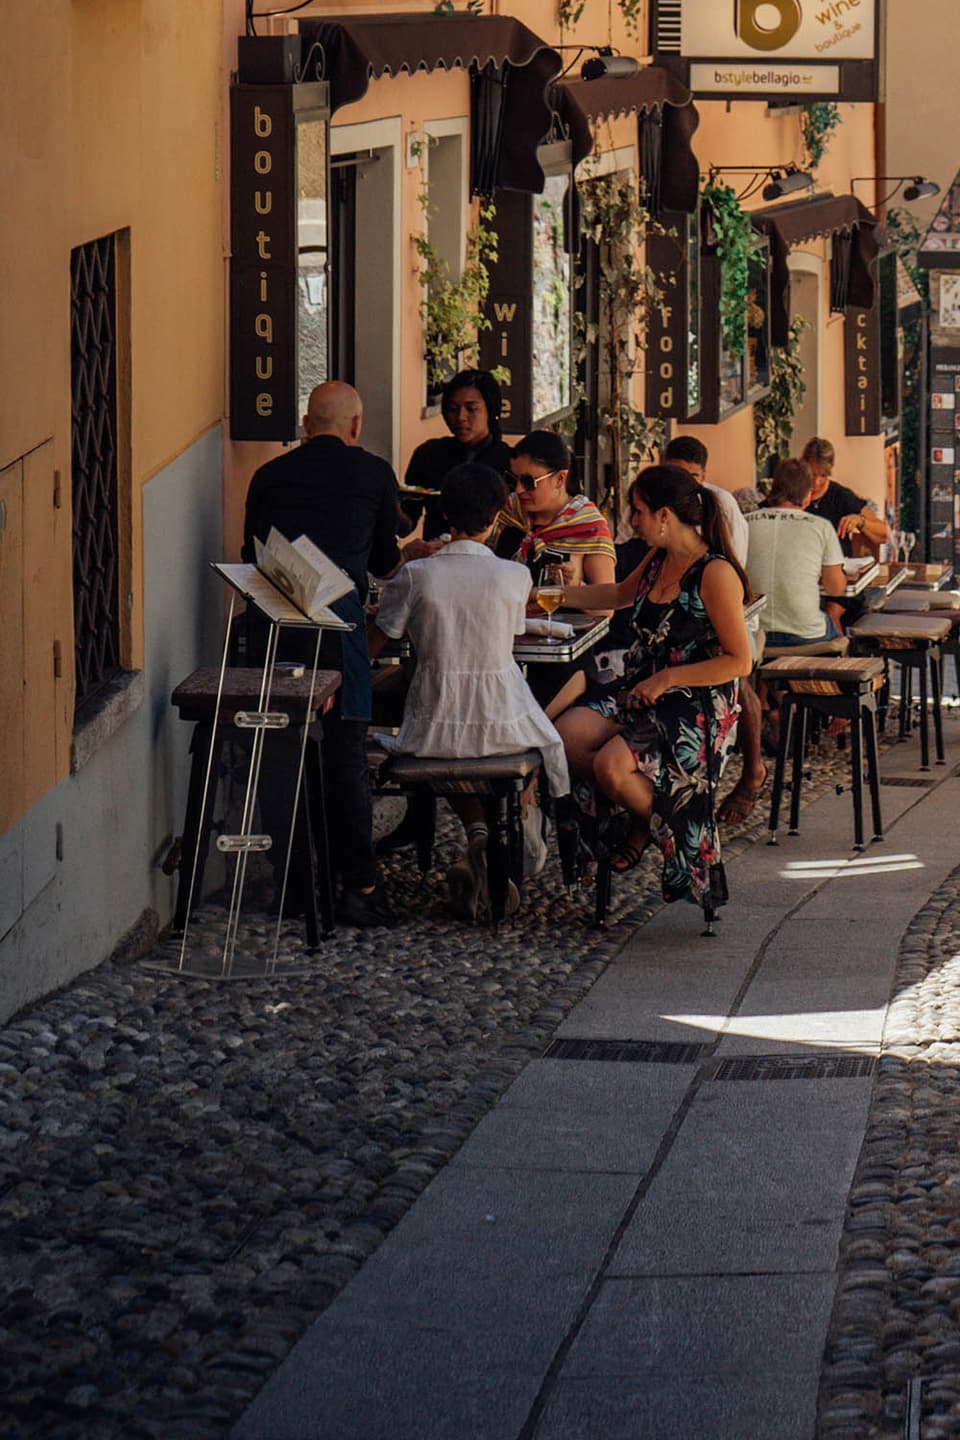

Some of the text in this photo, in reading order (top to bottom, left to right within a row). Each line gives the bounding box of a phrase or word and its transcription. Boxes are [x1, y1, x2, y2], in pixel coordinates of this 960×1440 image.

[714, 71, 800, 86] bstylebellagio
[814, 23, 862, 52] boutique
[254, 106, 273, 416] boutique
[493, 303, 517, 418] wine
[659, 306, 673, 408] food
[856, 314, 868, 433] cktail
